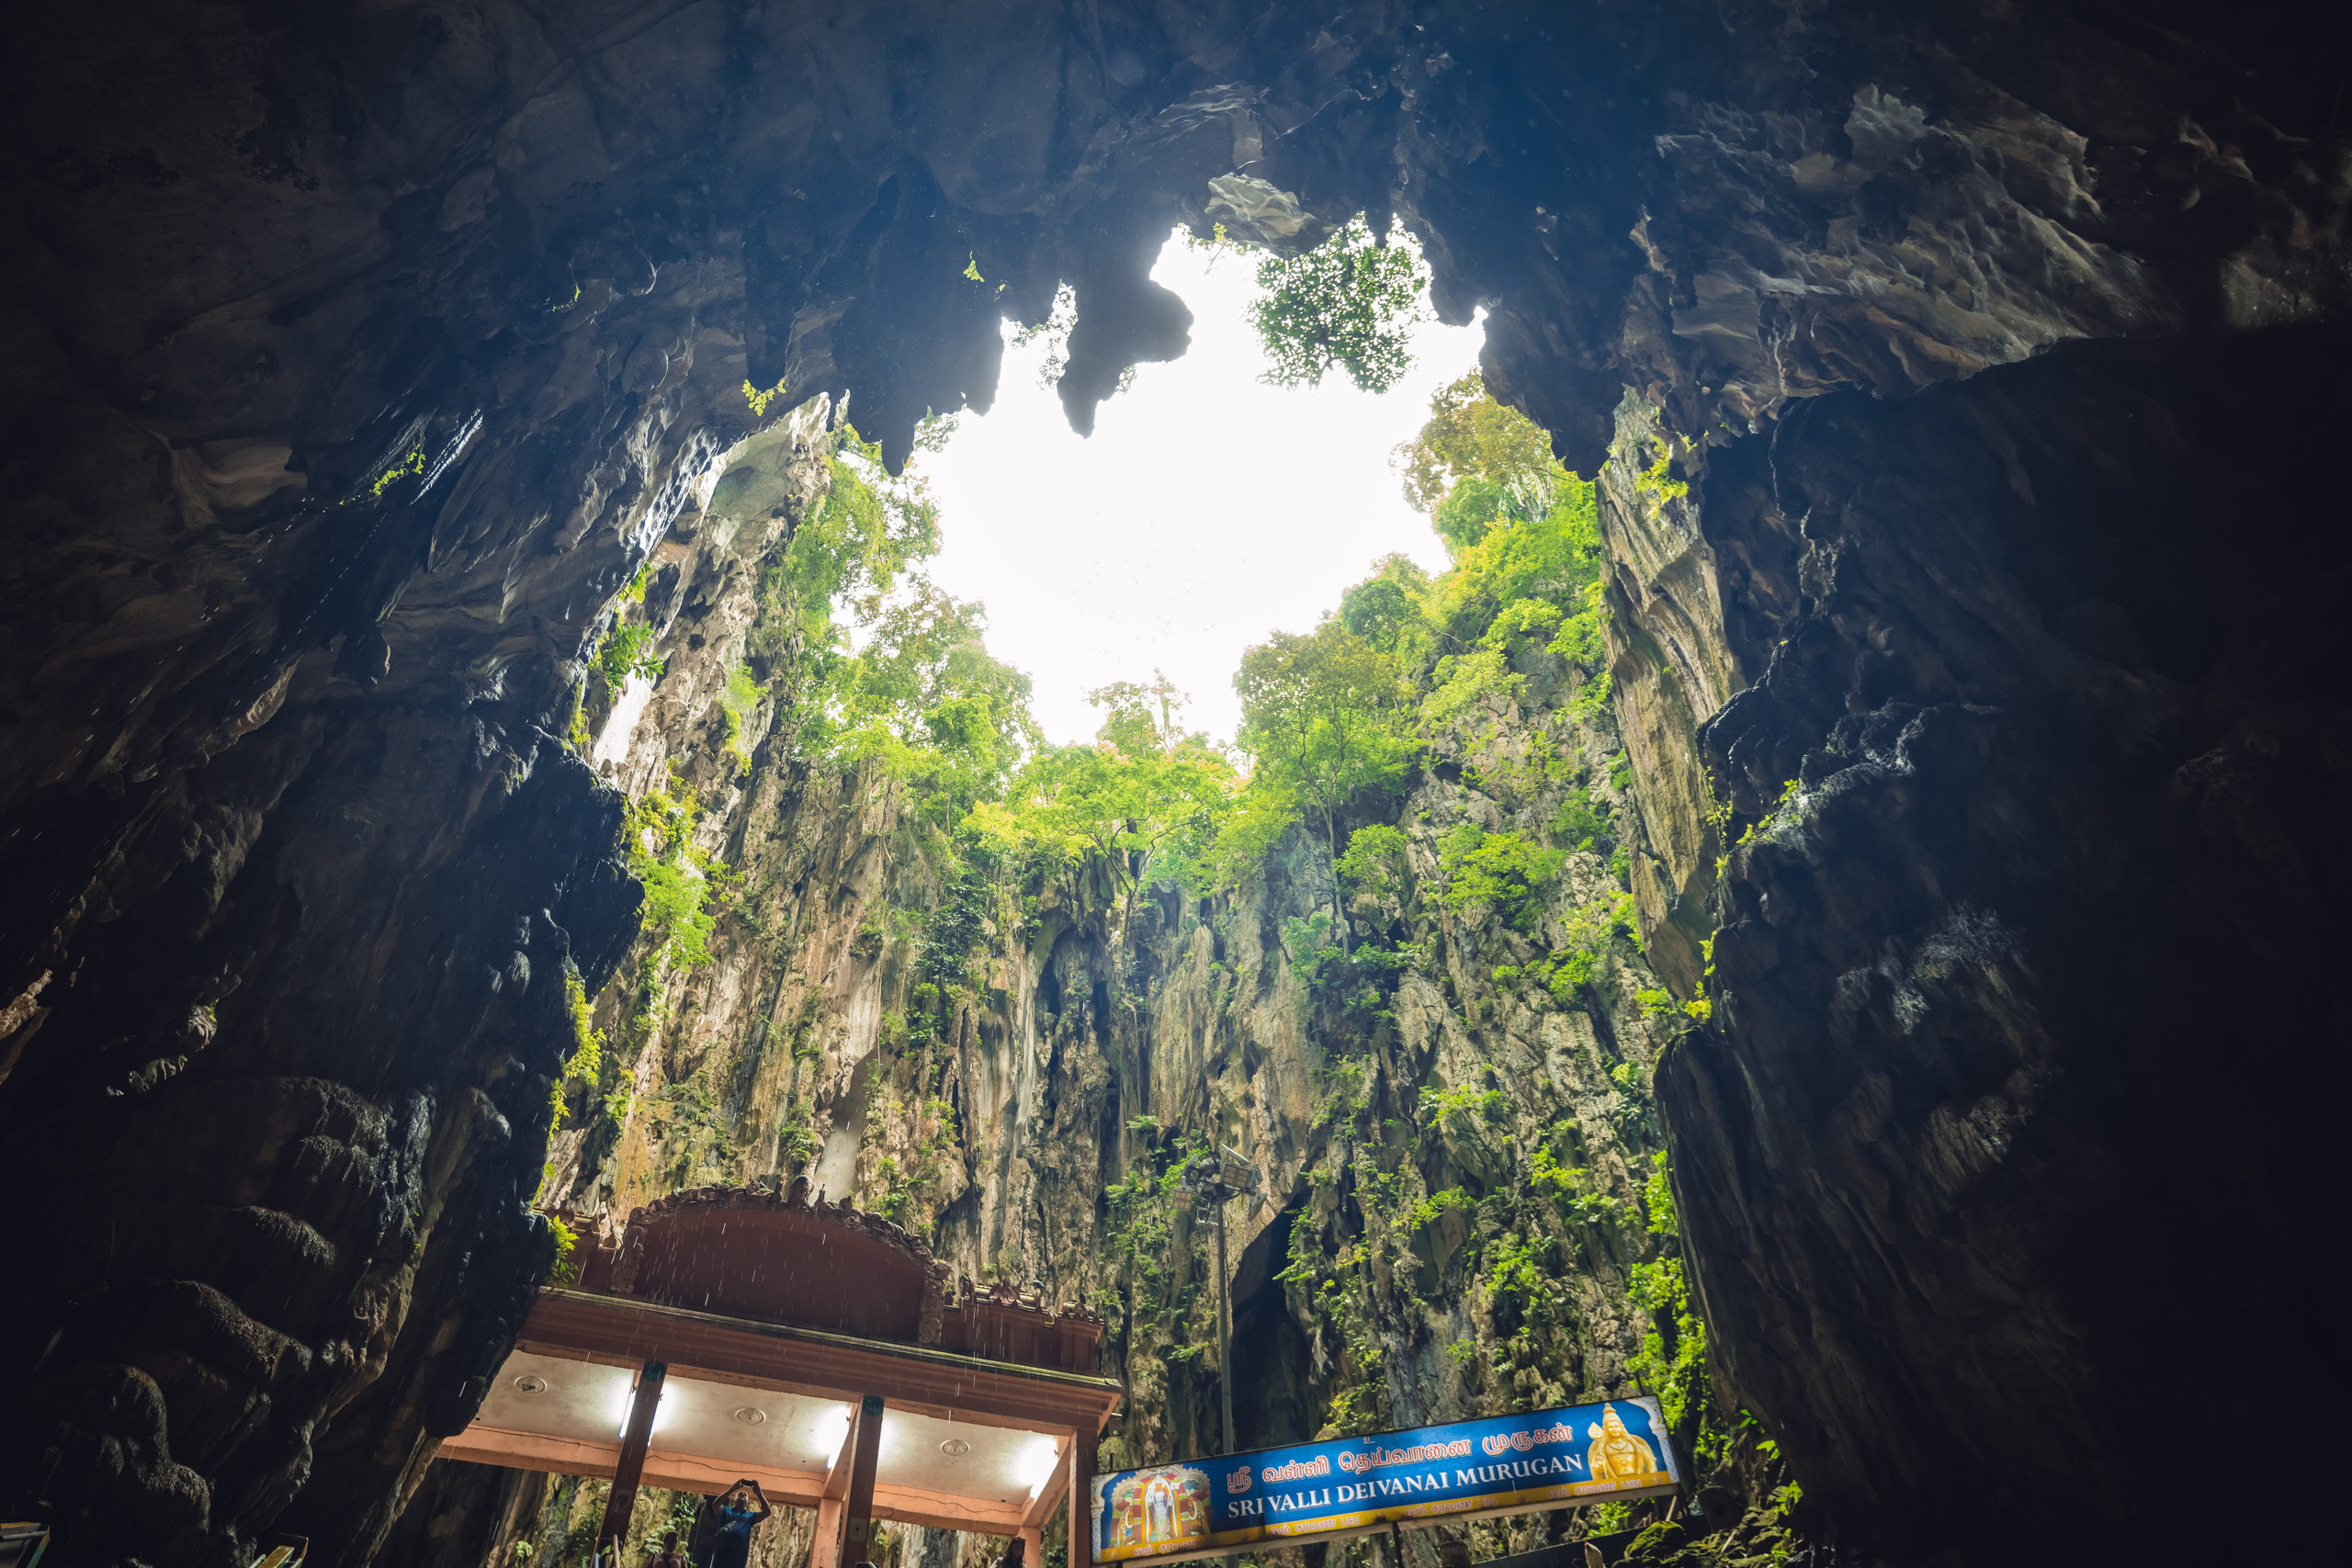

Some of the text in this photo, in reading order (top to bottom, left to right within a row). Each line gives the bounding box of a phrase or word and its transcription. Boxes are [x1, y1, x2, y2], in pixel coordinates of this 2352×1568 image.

[1227, 1422, 1573, 1494] ஸ்ரீ வள்ளி தெய்வானை முருகன்
[1228, 1454, 1583, 1518] SRI VALLI DEIVANAI MURUGAN
